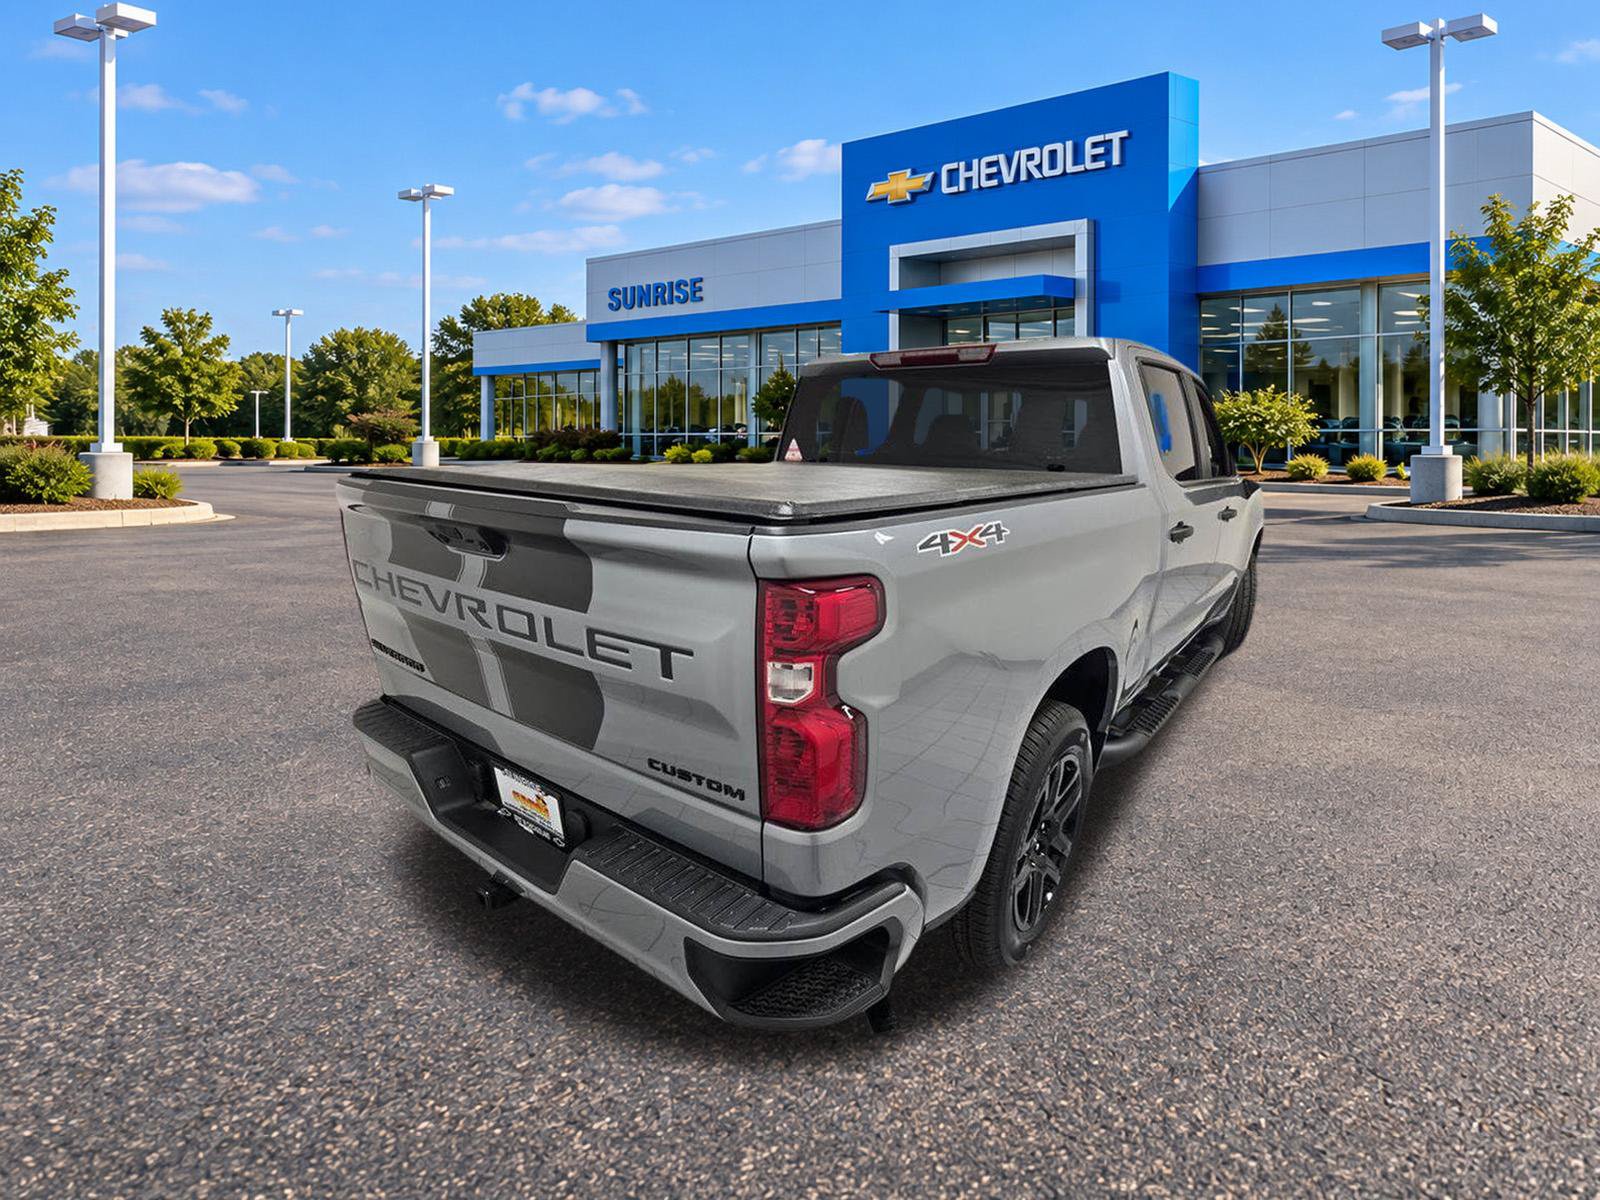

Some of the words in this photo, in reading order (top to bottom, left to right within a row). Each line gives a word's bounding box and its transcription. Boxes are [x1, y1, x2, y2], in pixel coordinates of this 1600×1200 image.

[941, 130, 1129, 194] CHEVROLET
[608, 277, 704, 312] SUNRISE
[352, 559, 694, 680] CHEVROLET
[647, 758, 745, 801] CUSTOM
